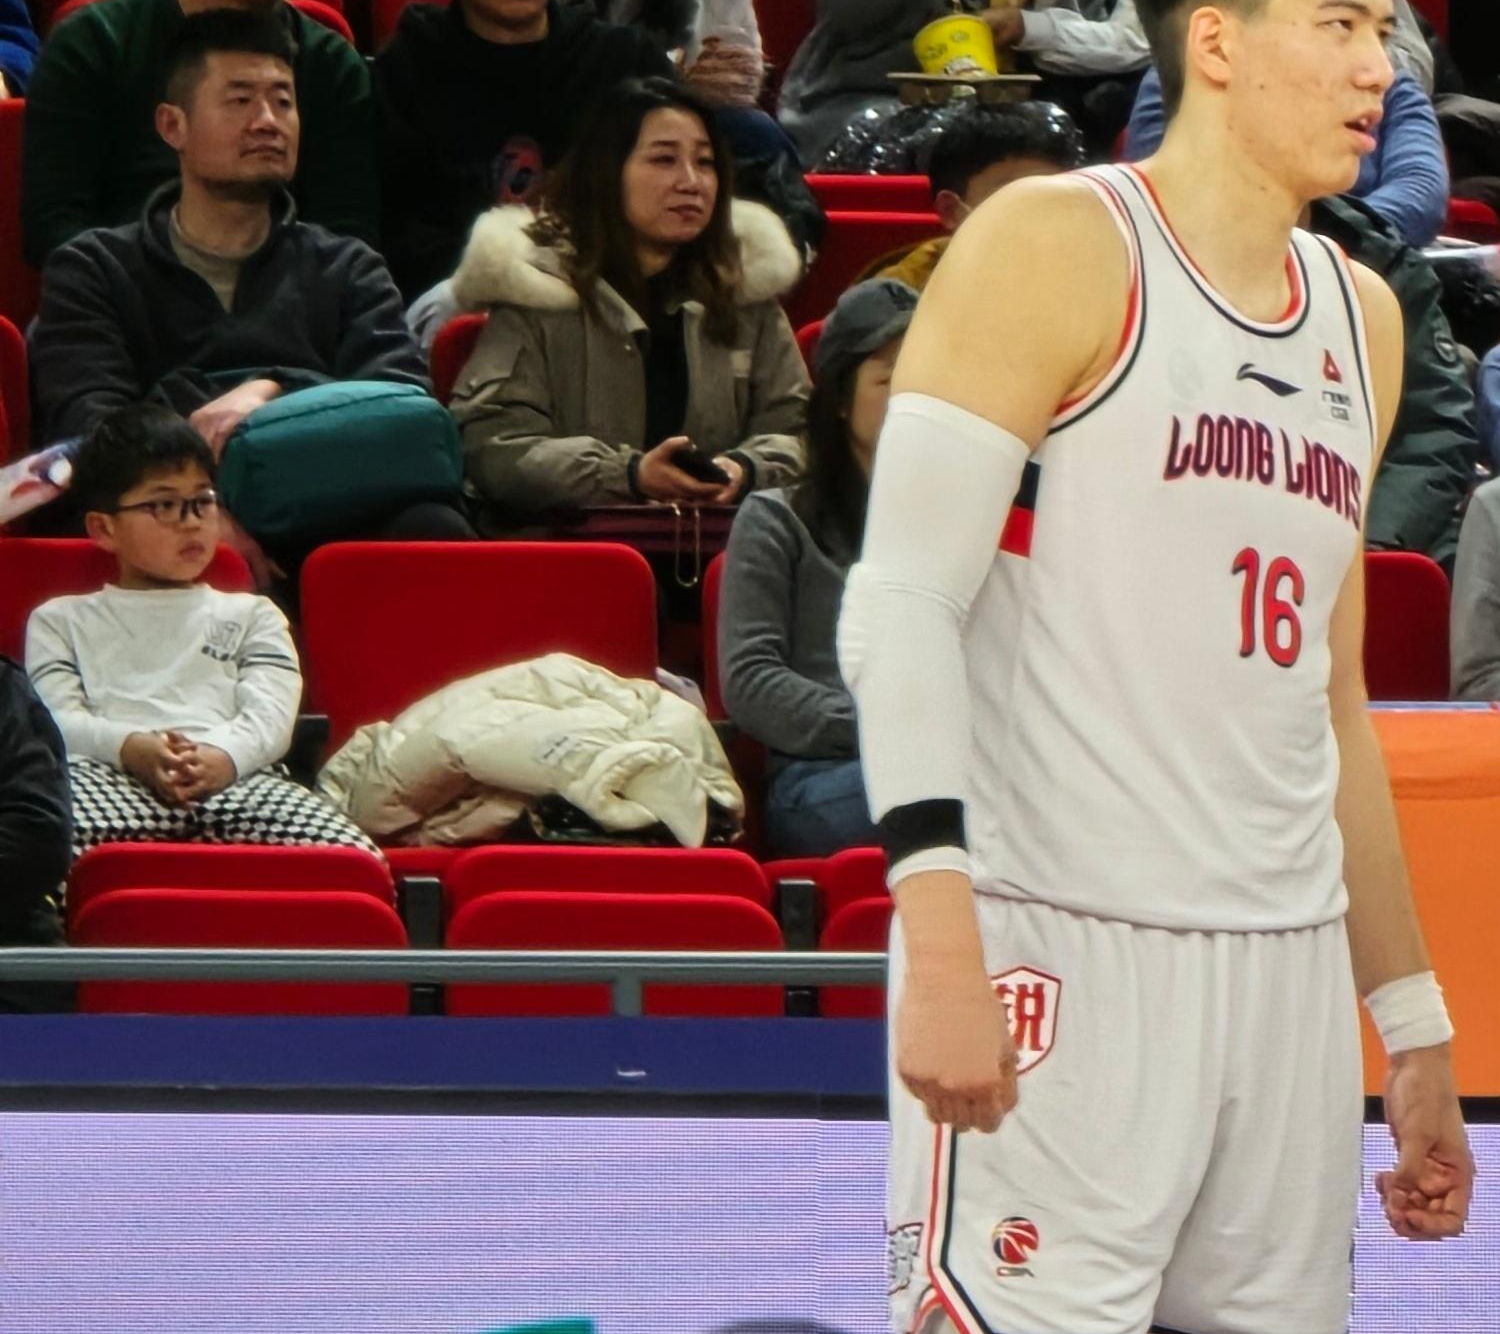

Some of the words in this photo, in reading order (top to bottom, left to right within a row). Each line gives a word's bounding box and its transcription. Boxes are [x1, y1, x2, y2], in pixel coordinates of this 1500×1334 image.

[1163, 412, 1275, 487] LOONG
[1279, 427, 1362, 532] LIONS
[1231, 547, 1305, 668] 16
